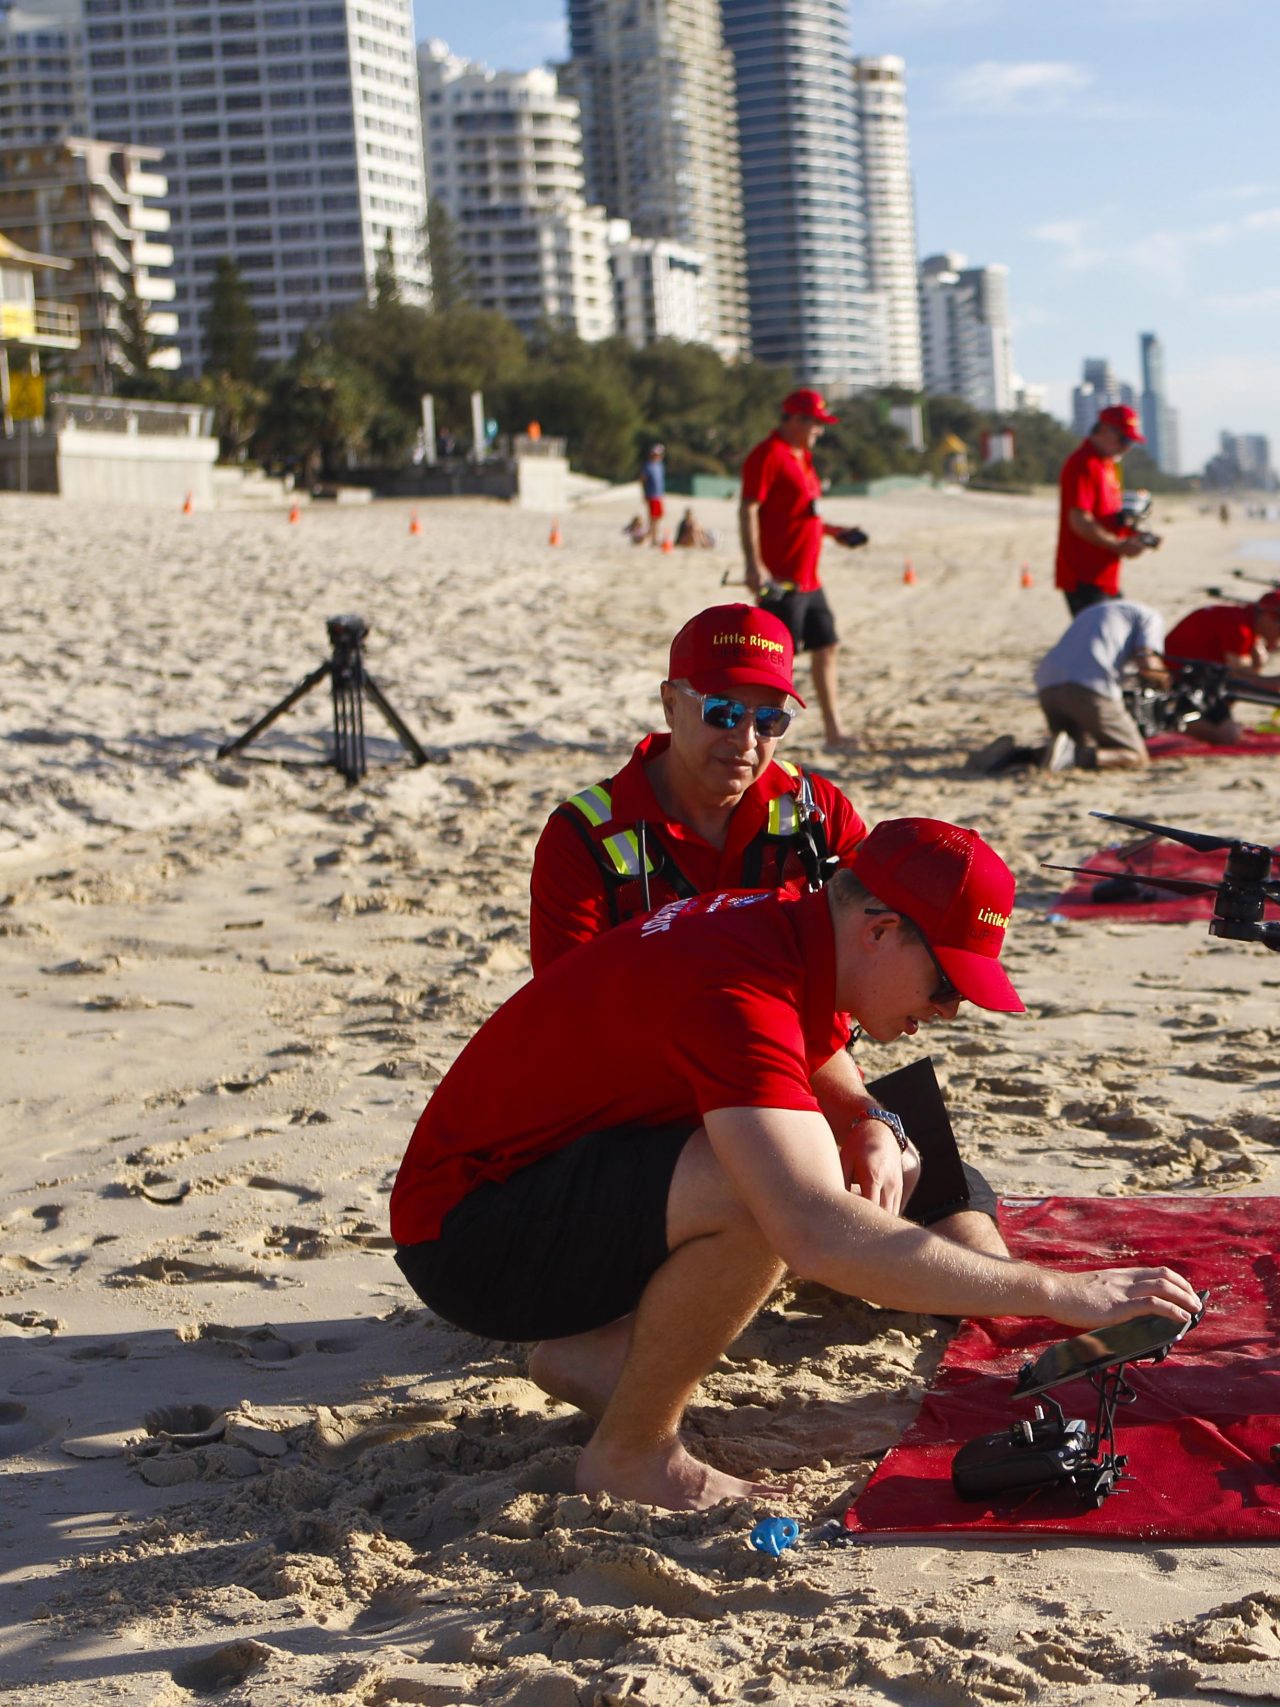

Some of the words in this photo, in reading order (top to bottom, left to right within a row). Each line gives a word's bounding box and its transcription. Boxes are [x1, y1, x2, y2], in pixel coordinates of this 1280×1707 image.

[713, 632, 746, 645] Little
[750, 633, 784, 653] Ripper
[978, 907, 1004, 927] Little
